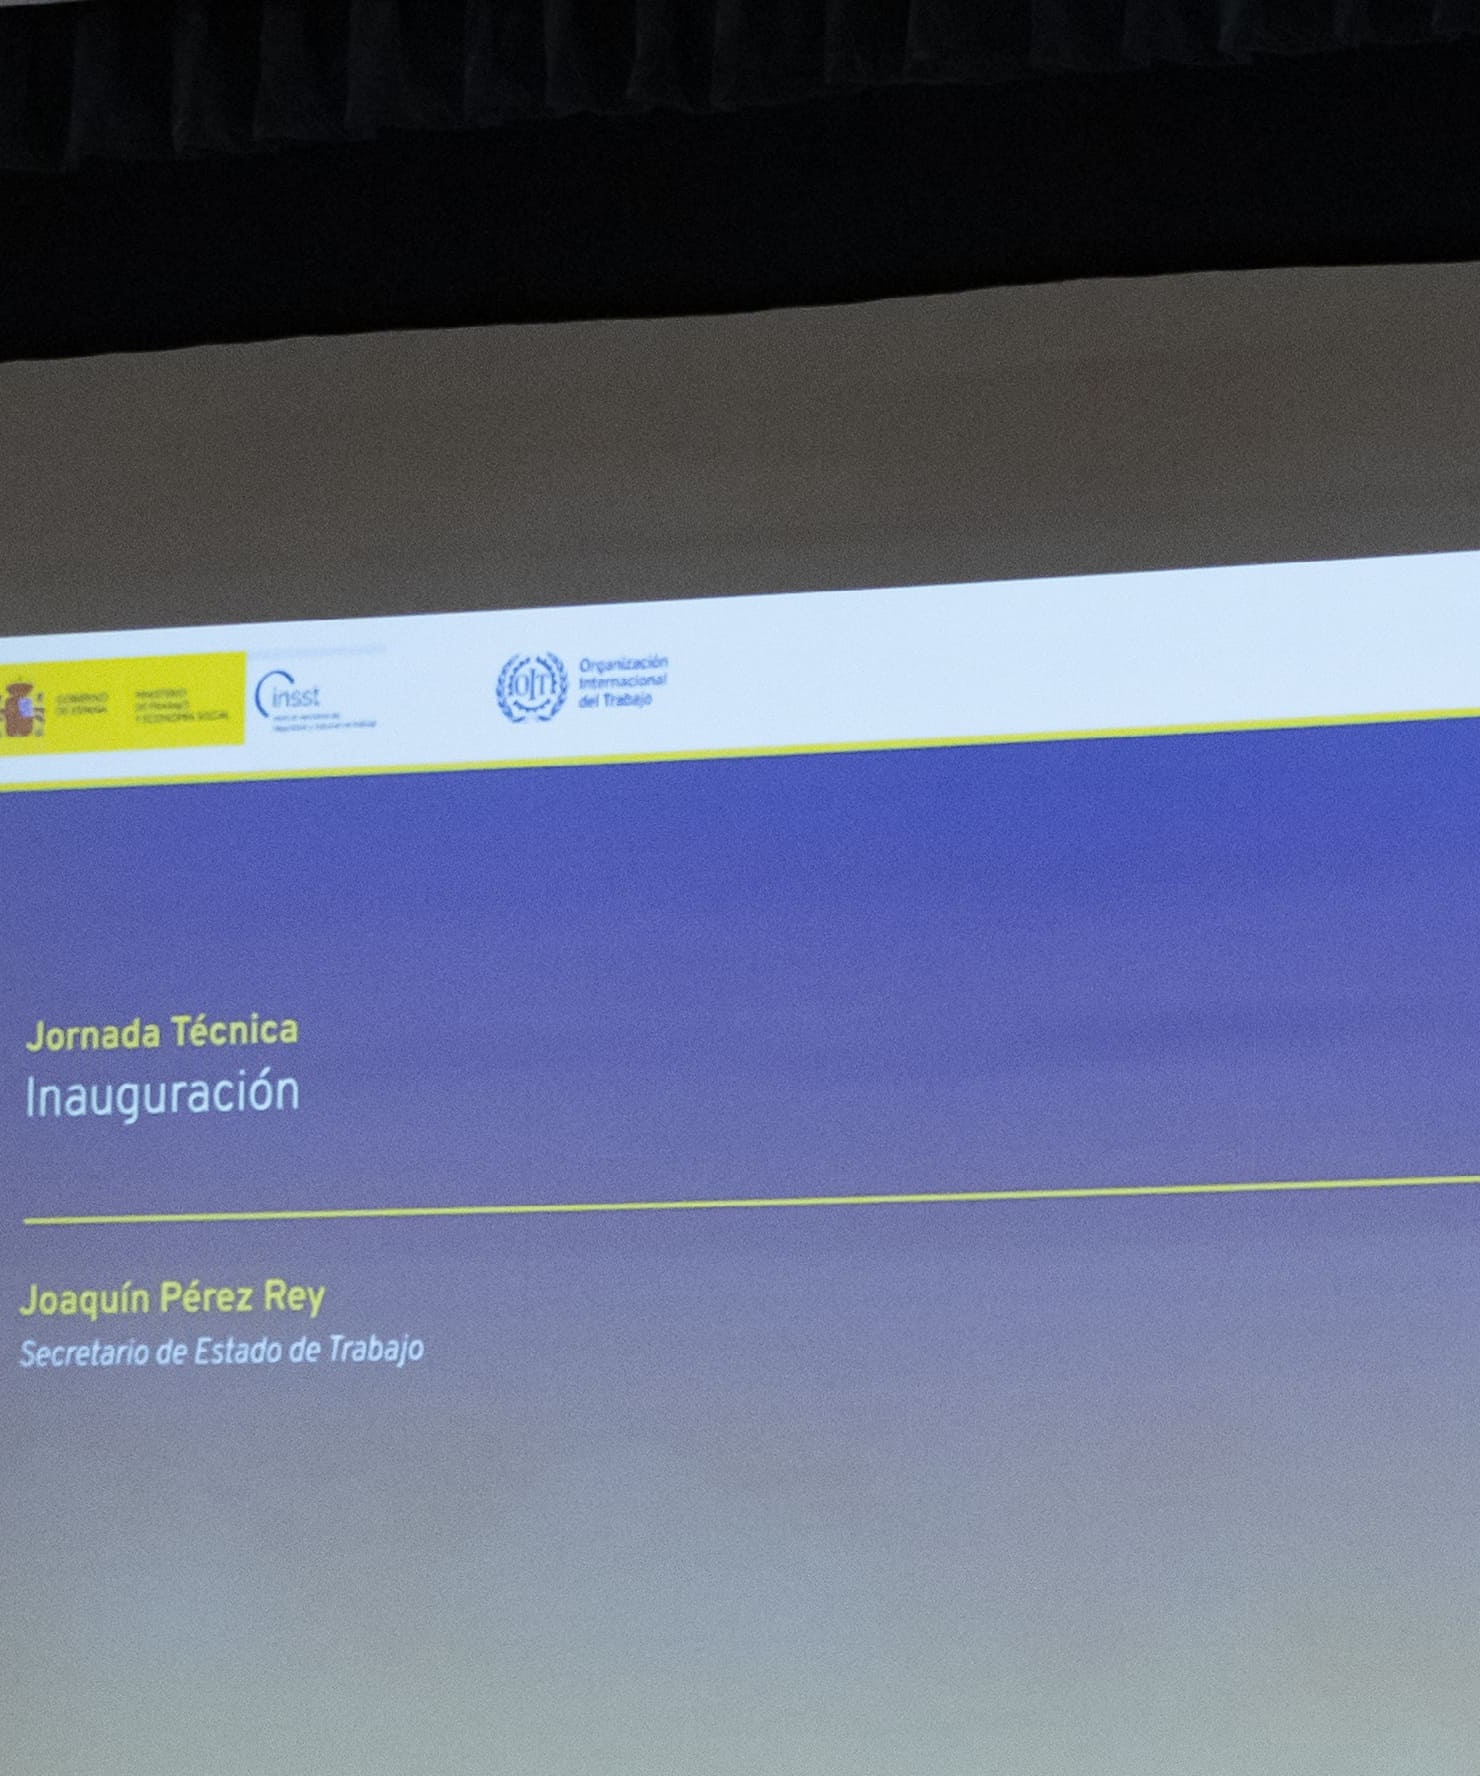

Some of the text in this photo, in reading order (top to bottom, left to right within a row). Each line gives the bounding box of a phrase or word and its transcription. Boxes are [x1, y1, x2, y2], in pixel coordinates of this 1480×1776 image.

[579, 655, 669, 674] Organización
[579, 673, 668, 689] Internacional
[272, 685, 321, 708] insst
[578, 692, 653, 708] del Trabajo
[26, 1012, 299, 1052] Jornada Técnica
[26, 1066, 299, 1125] Inauguración
[19, 1278, 325, 1322] Joaquín Pérez Rey
[20, 1332, 424, 1368] Secretario de Estado de Trabajo
